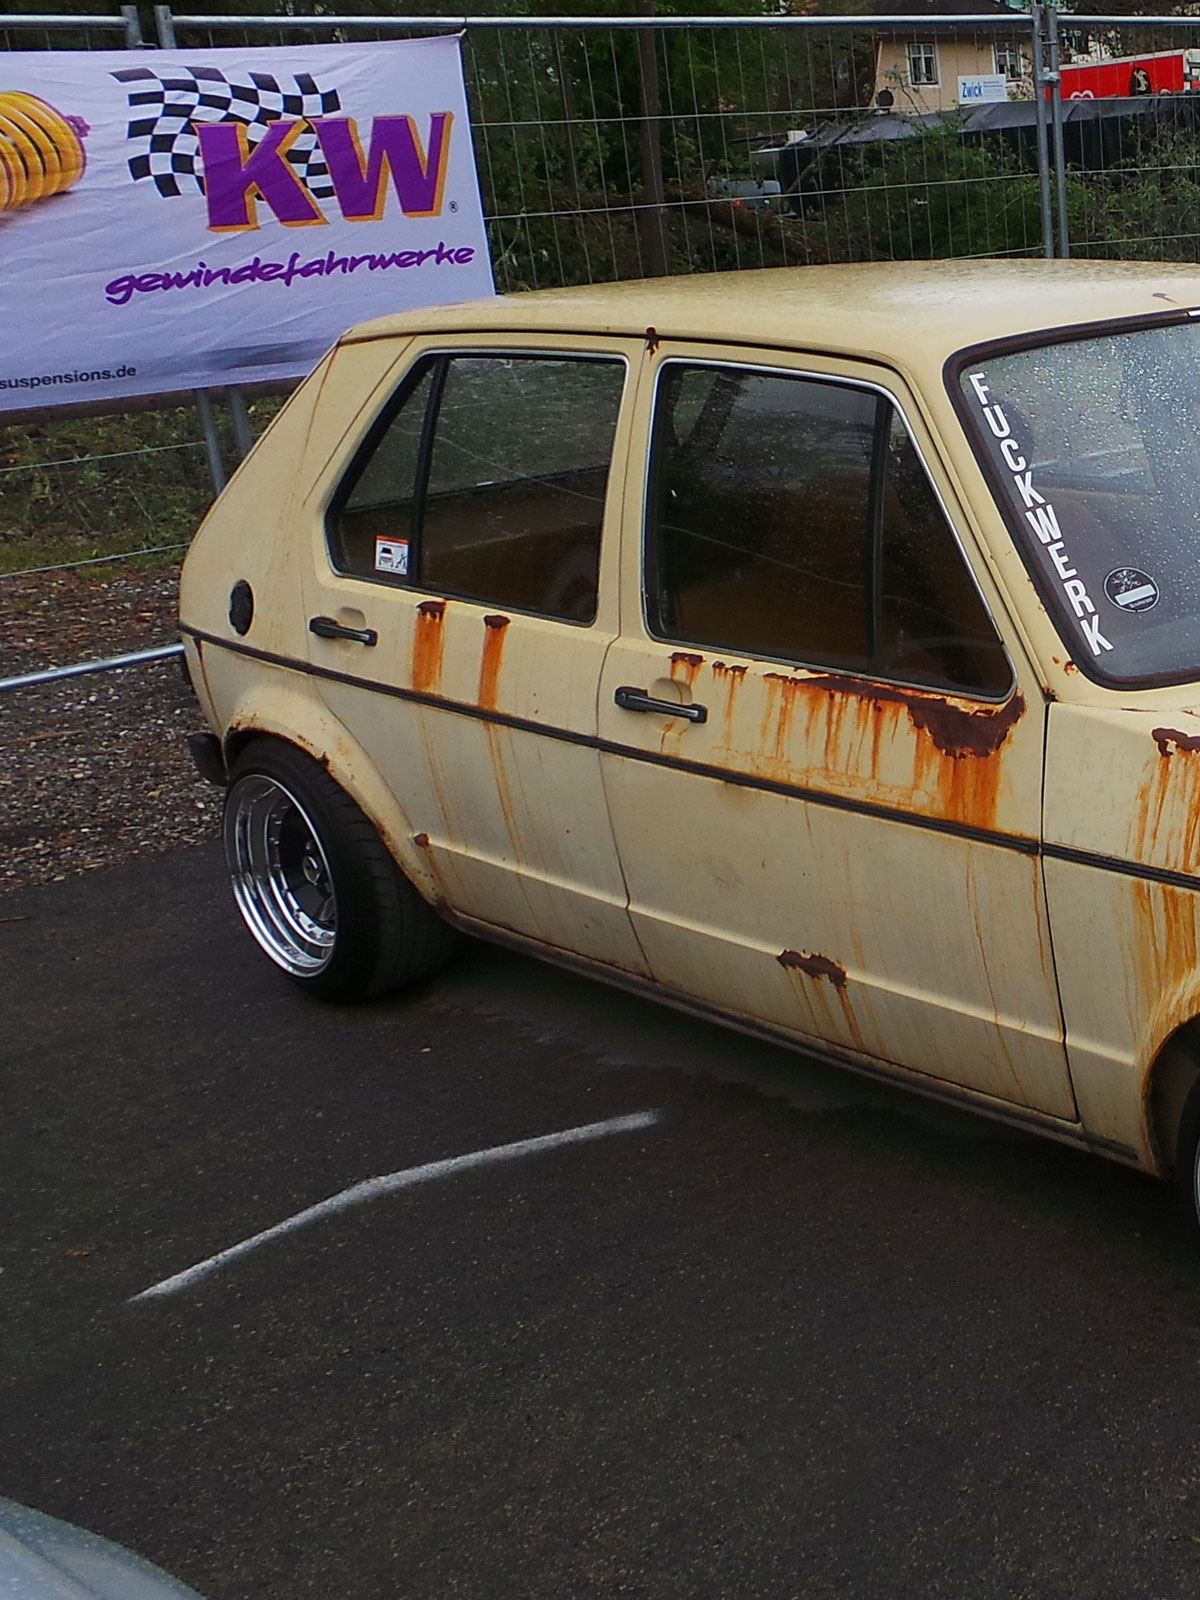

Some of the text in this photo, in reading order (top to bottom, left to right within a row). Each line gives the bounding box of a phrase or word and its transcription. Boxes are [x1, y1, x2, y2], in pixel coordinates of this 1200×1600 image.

[962, 81, 983, 98] Zwick
[191, 110, 455, 233] KW
[105, 241, 475, 305] gewindefahrwerke
[0, 365, 137, 390] suspensions.de
[969, 372, 1114, 657] FUCKWERK
